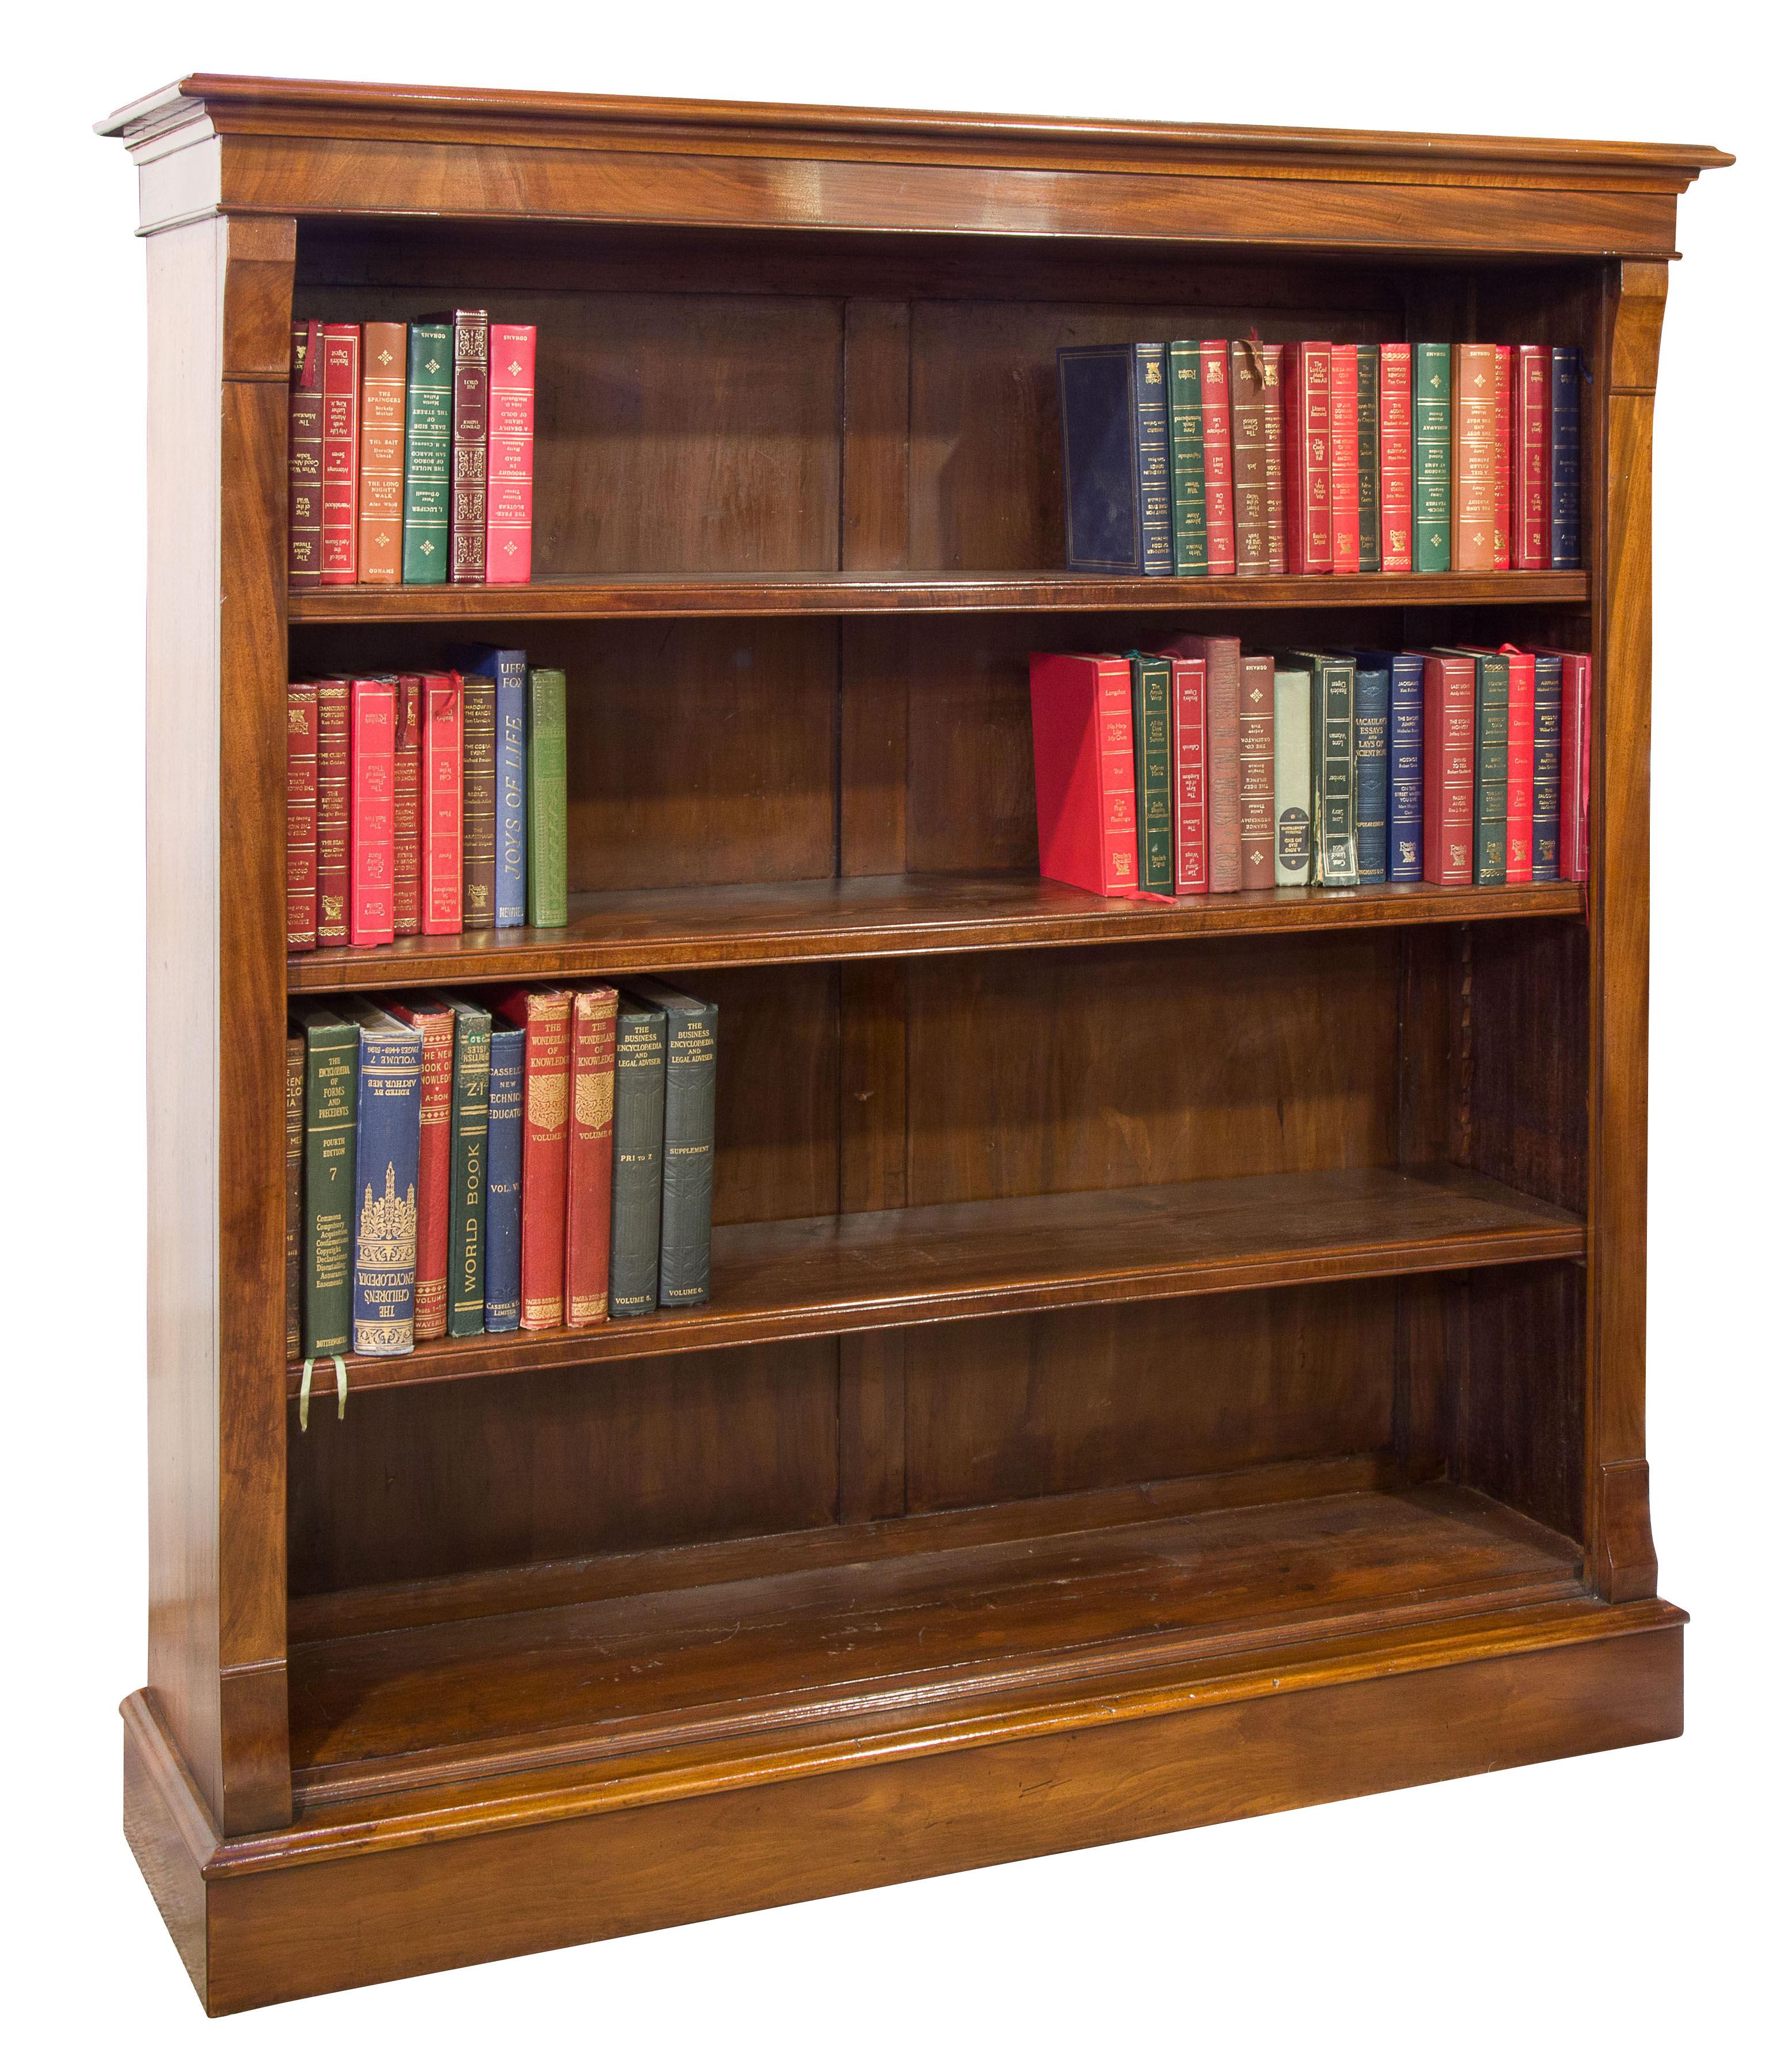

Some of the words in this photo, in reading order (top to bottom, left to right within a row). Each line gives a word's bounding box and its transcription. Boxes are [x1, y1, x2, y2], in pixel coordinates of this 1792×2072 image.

[500, 662, 526, 674] UFFA
[503, 677, 523, 688] FOX
[505, 714, 522, 772] LIFE
[505, 776, 522, 808] OF
[505, 817, 522, 880] JOYS
[545, 1024, 561, 1032] THE
[592, 1022, 607, 1031] THE
[634, 1026, 649, 1034] THE
[687, 1022, 702, 1030] THE
[625, 1034, 657, 1042] BUSINESS
[678, 1029, 710, 1039] BUSINESS
[467, 1045, 486, 1053] ISLES
[595, 1046, 604, 1054] OF
[329, 1057, 341, 1065] THE
[370, 1056, 376, 1064] 7
[380, 1056, 416, 1064] VOLUME
[463, 1053, 489, 1062] BRITISH
[618, 1058, 638, 1068] LEGAL
[638, 1057, 661, 1066] ADVISER
[671, 1055, 691, 1064] LEGAL
[691, 1053, 713, 1062] ADVISER
[330, 1077, 338, 1085] OF
[367, 1079, 383, 1087] MEE
[385, 1079, 417, 1088] ARTHUR
[323, 1086, 345, 1098] FORMS
[328, 1099, 340, 1107] AND
[425, 1094, 448, 1102] A-BON
[318, 1106, 349, 1118] PRECEDENTS
[579, 1130, 608, 1140] VOLUME
[323, 1137, 345, 1147] FOURTH
[323, 1148, 345, 1157] EDITION
[669, 1145, 710, 1155] SUPPLEMENT
[329, 1167, 337, 1181] 7
[467, 1142, 480, 1205] BOOK
[317, 1213, 341, 1222] Commons
[317, 1221, 345, 1232] Compulsory
[316, 1246, 341, 1256] Copyright
[465, 1218, 478, 1293] WORLD
[316, 1279, 343, 1288] Easements
[358, 1271, 414, 1287] ENCYCLOPEDIA
[364, 1289, 409, 1305] CHILDREN'S
[615, 1296, 645, 1304] VOLUME
[379, 1305, 395, 1317] THE
